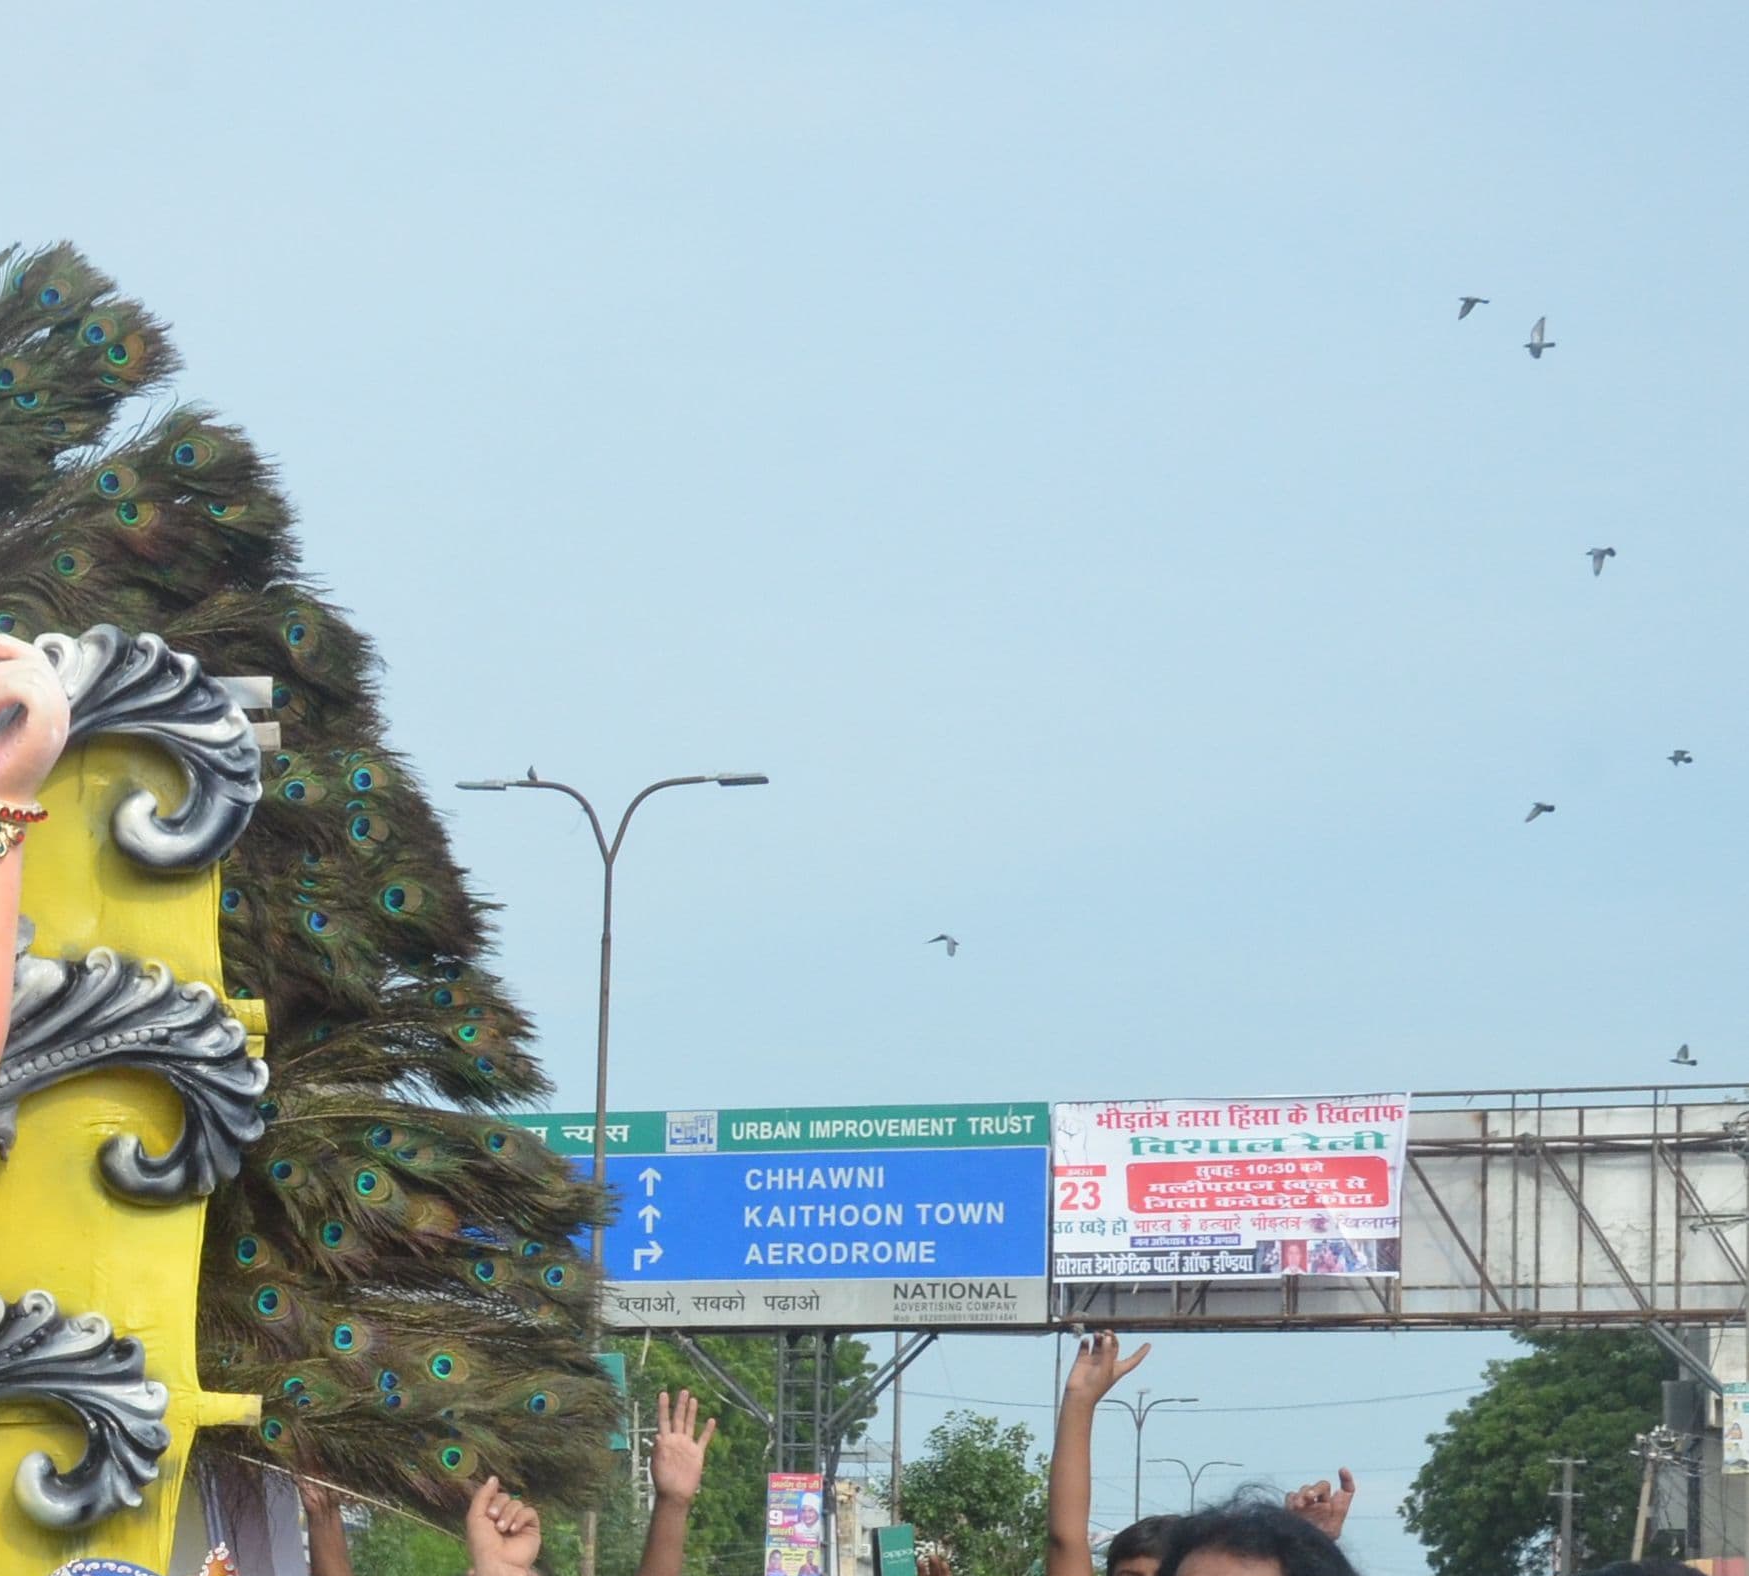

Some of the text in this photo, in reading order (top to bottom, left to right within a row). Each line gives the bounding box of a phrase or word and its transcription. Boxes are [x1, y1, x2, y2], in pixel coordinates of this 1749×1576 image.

[1176, 1109, 1222, 1128] द्वारा
[1228, 1104, 1280, 1130] हिंसा
[1286, 1103, 1310, 1125] के
[1316, 1102, 1406, 1124] खिलाफ
[731, 1114, 1035, 1141] URBAN IMPROVEMENT TRUST
[1129, 1135, 1288, 1156] विशाल
[745, 1166, 885, 1191] CHHAWNI
[1246, 1162, 1296, 1176] 10:30
[1282, 1177, 1339, 1194] स्कूल
[1345, 1175, 1369, 1190] से
[1059, 1181, 1102, 1211] 23
[1314, 1190, 1375, 1205] कोटा
[744, 1201, 1005, 1228] KAITHOON TOWN
[1112, 1216, 1128, 1235] हो
[744, 1241, 937, 1265] AERODROME
[1056, 1254, 1094, 1276] सोशल
[1154, 1251, 1180, 1273] पार्टी
[618, 1290, 681, 1315] बचाओ,
[691, 1289, 745, 1312] सबको
[893, 1282, 1018, 1300] NATIONAL
[893, 1301, 1018, 1312] ADVERTISING COMPANY
[768, 1509, 784, 1526] 9
